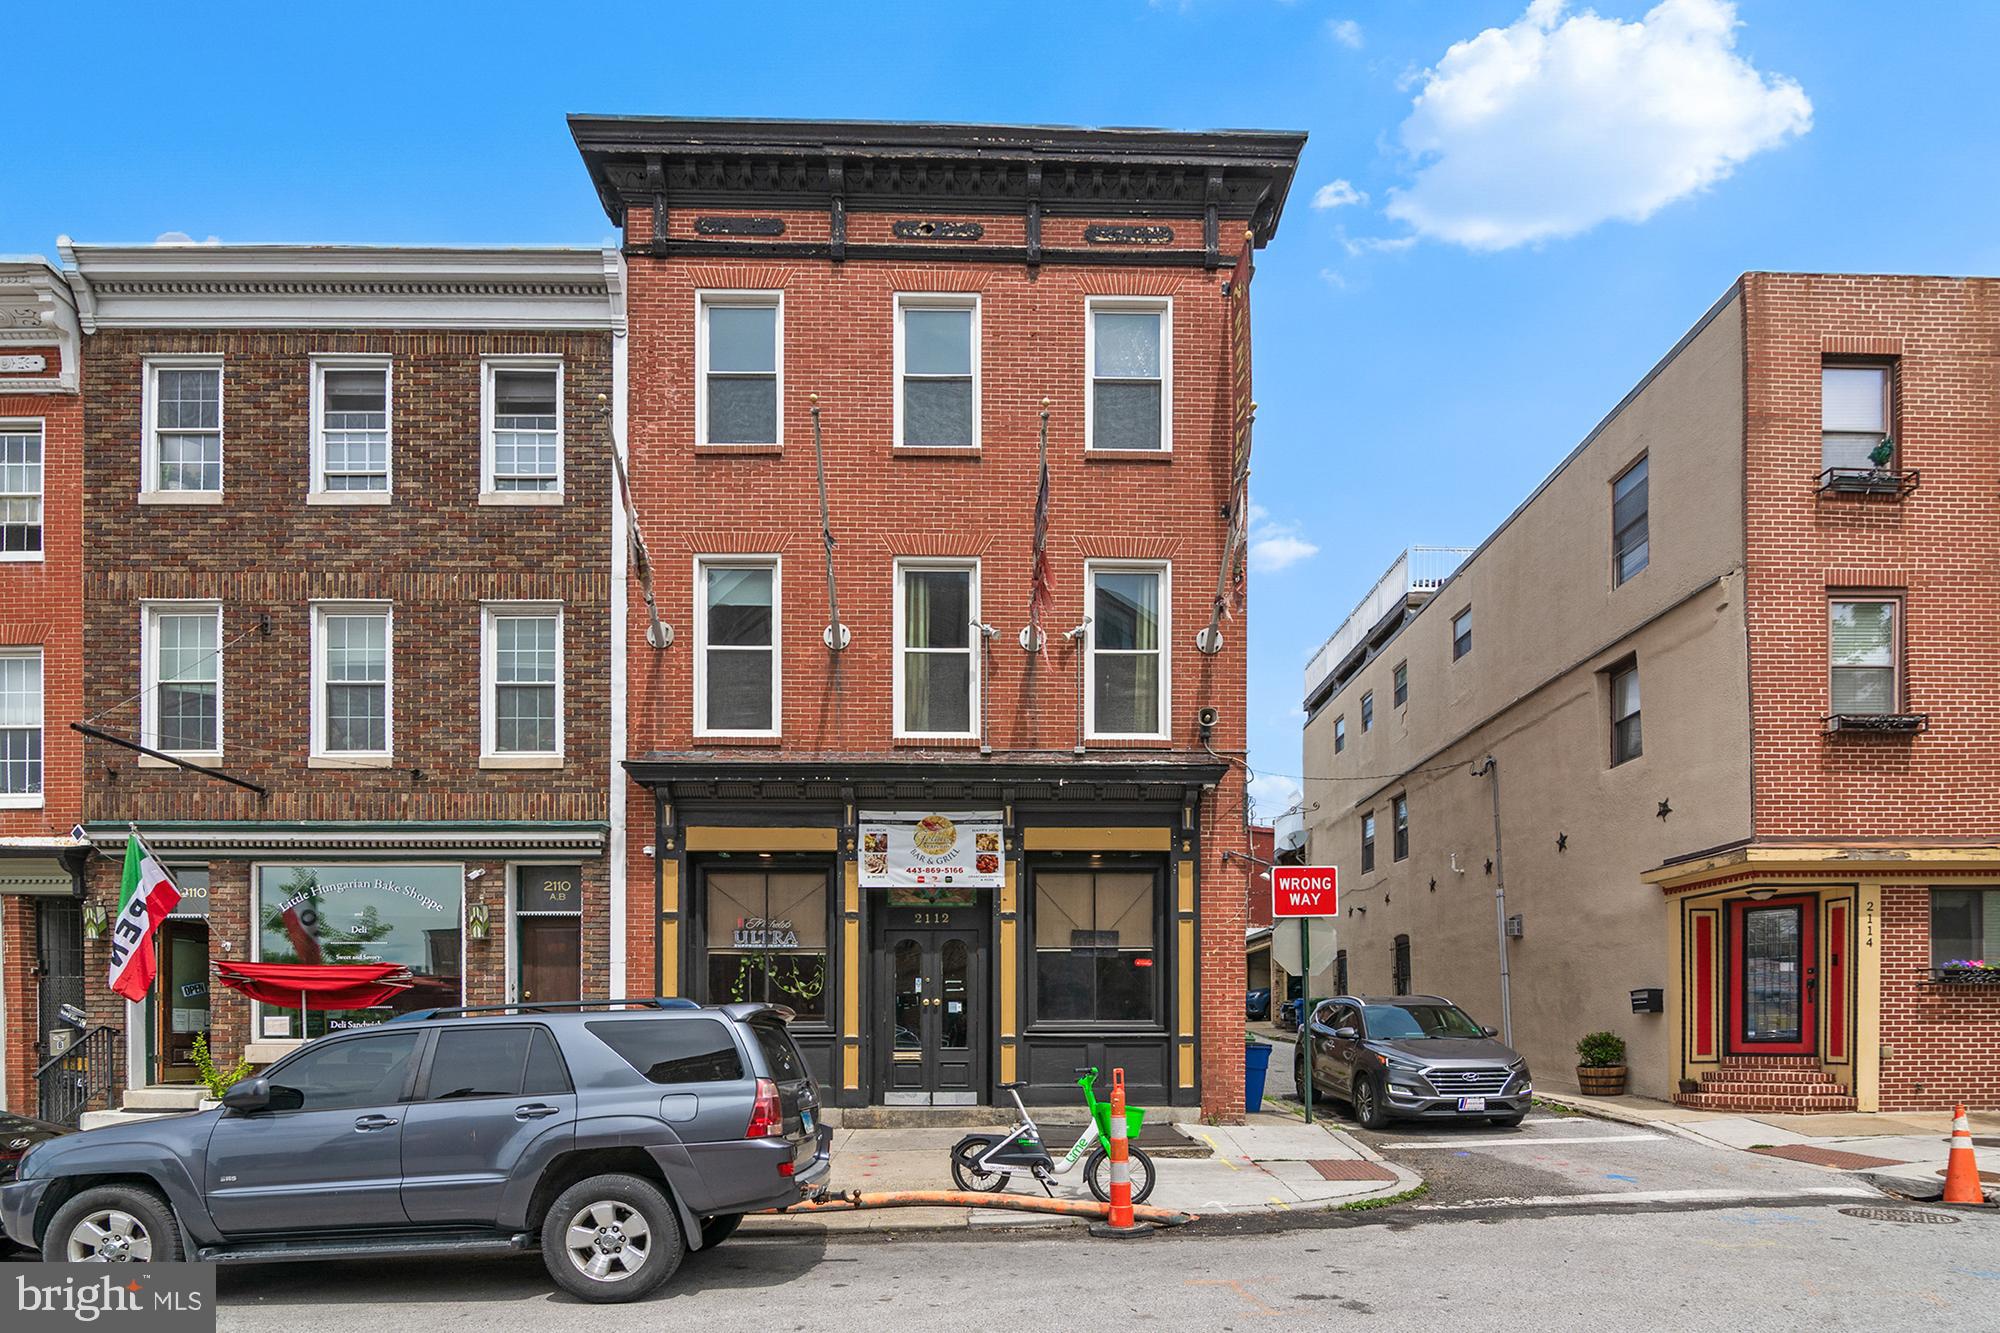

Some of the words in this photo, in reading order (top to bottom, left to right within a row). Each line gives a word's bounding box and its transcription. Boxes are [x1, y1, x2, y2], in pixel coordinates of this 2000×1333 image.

[910, 848, 926, 863] BAR
[927, 857, 934, 865] &
[936, 848, 961, 865] GRILL
[543, 880, 571, 891] 2110
[1279, 877, 1332, 890] WRONG
[182, 887, 207, 898] 2110
[278, 891, 310, 913] Little
[310, 879, 371, 896] Hungarian
[374, 879, 402, 894] Bake
[403, 885, 445, 912] Shoppe
[1289, 893, 1321, 906] WAY
[745, 917, 792, 929] Mihelob
[914, 913, 949, 924] 2112
[1866, 901, 1874, 948] 2114
[111, 897, 148, 968] PEN
[351, 925, 368, 934] Deli
[734, 930, 798, 945] ULTRA
[330, 1020, 347, 1029] Deli
